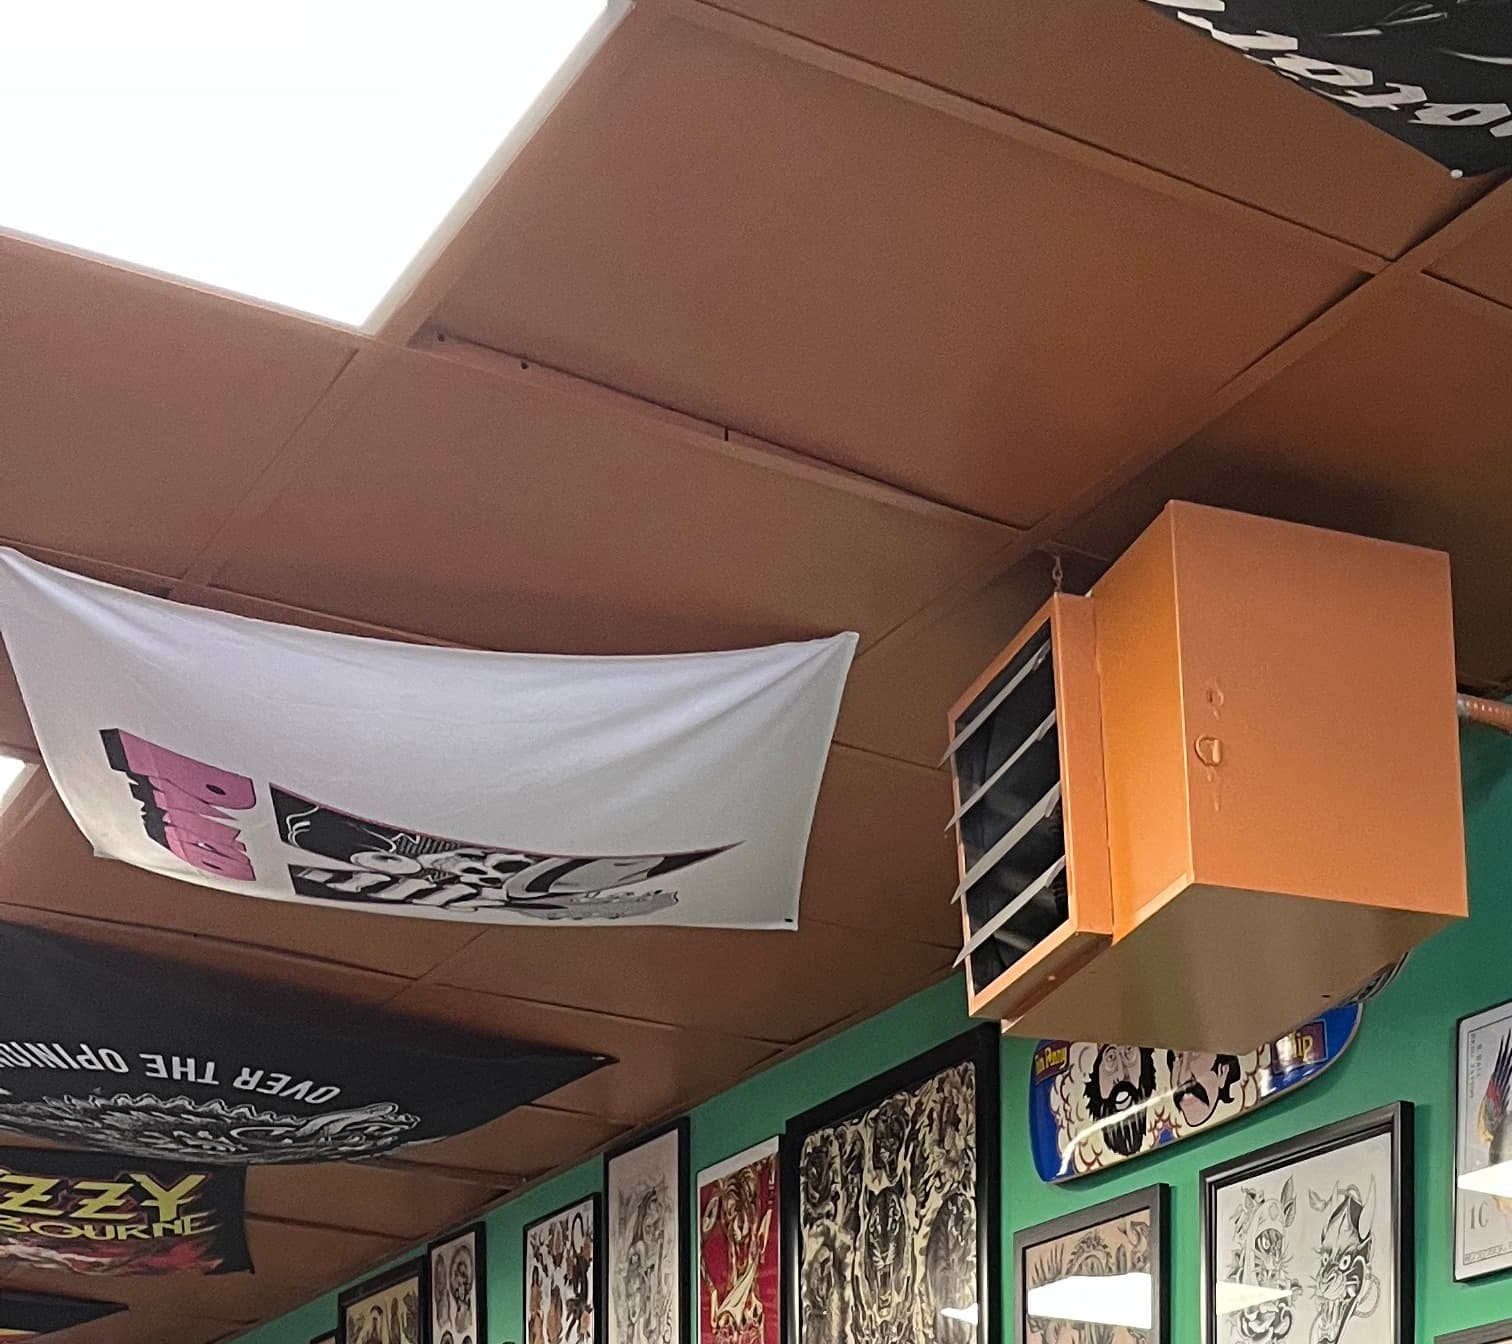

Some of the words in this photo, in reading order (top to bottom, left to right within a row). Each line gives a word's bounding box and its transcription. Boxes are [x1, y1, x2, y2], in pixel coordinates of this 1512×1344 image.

[139, 1053, 220, 1086] THE
[232, 1066, 341, 1105] OVER
[0, 1166, 208, 1222] ZZY
